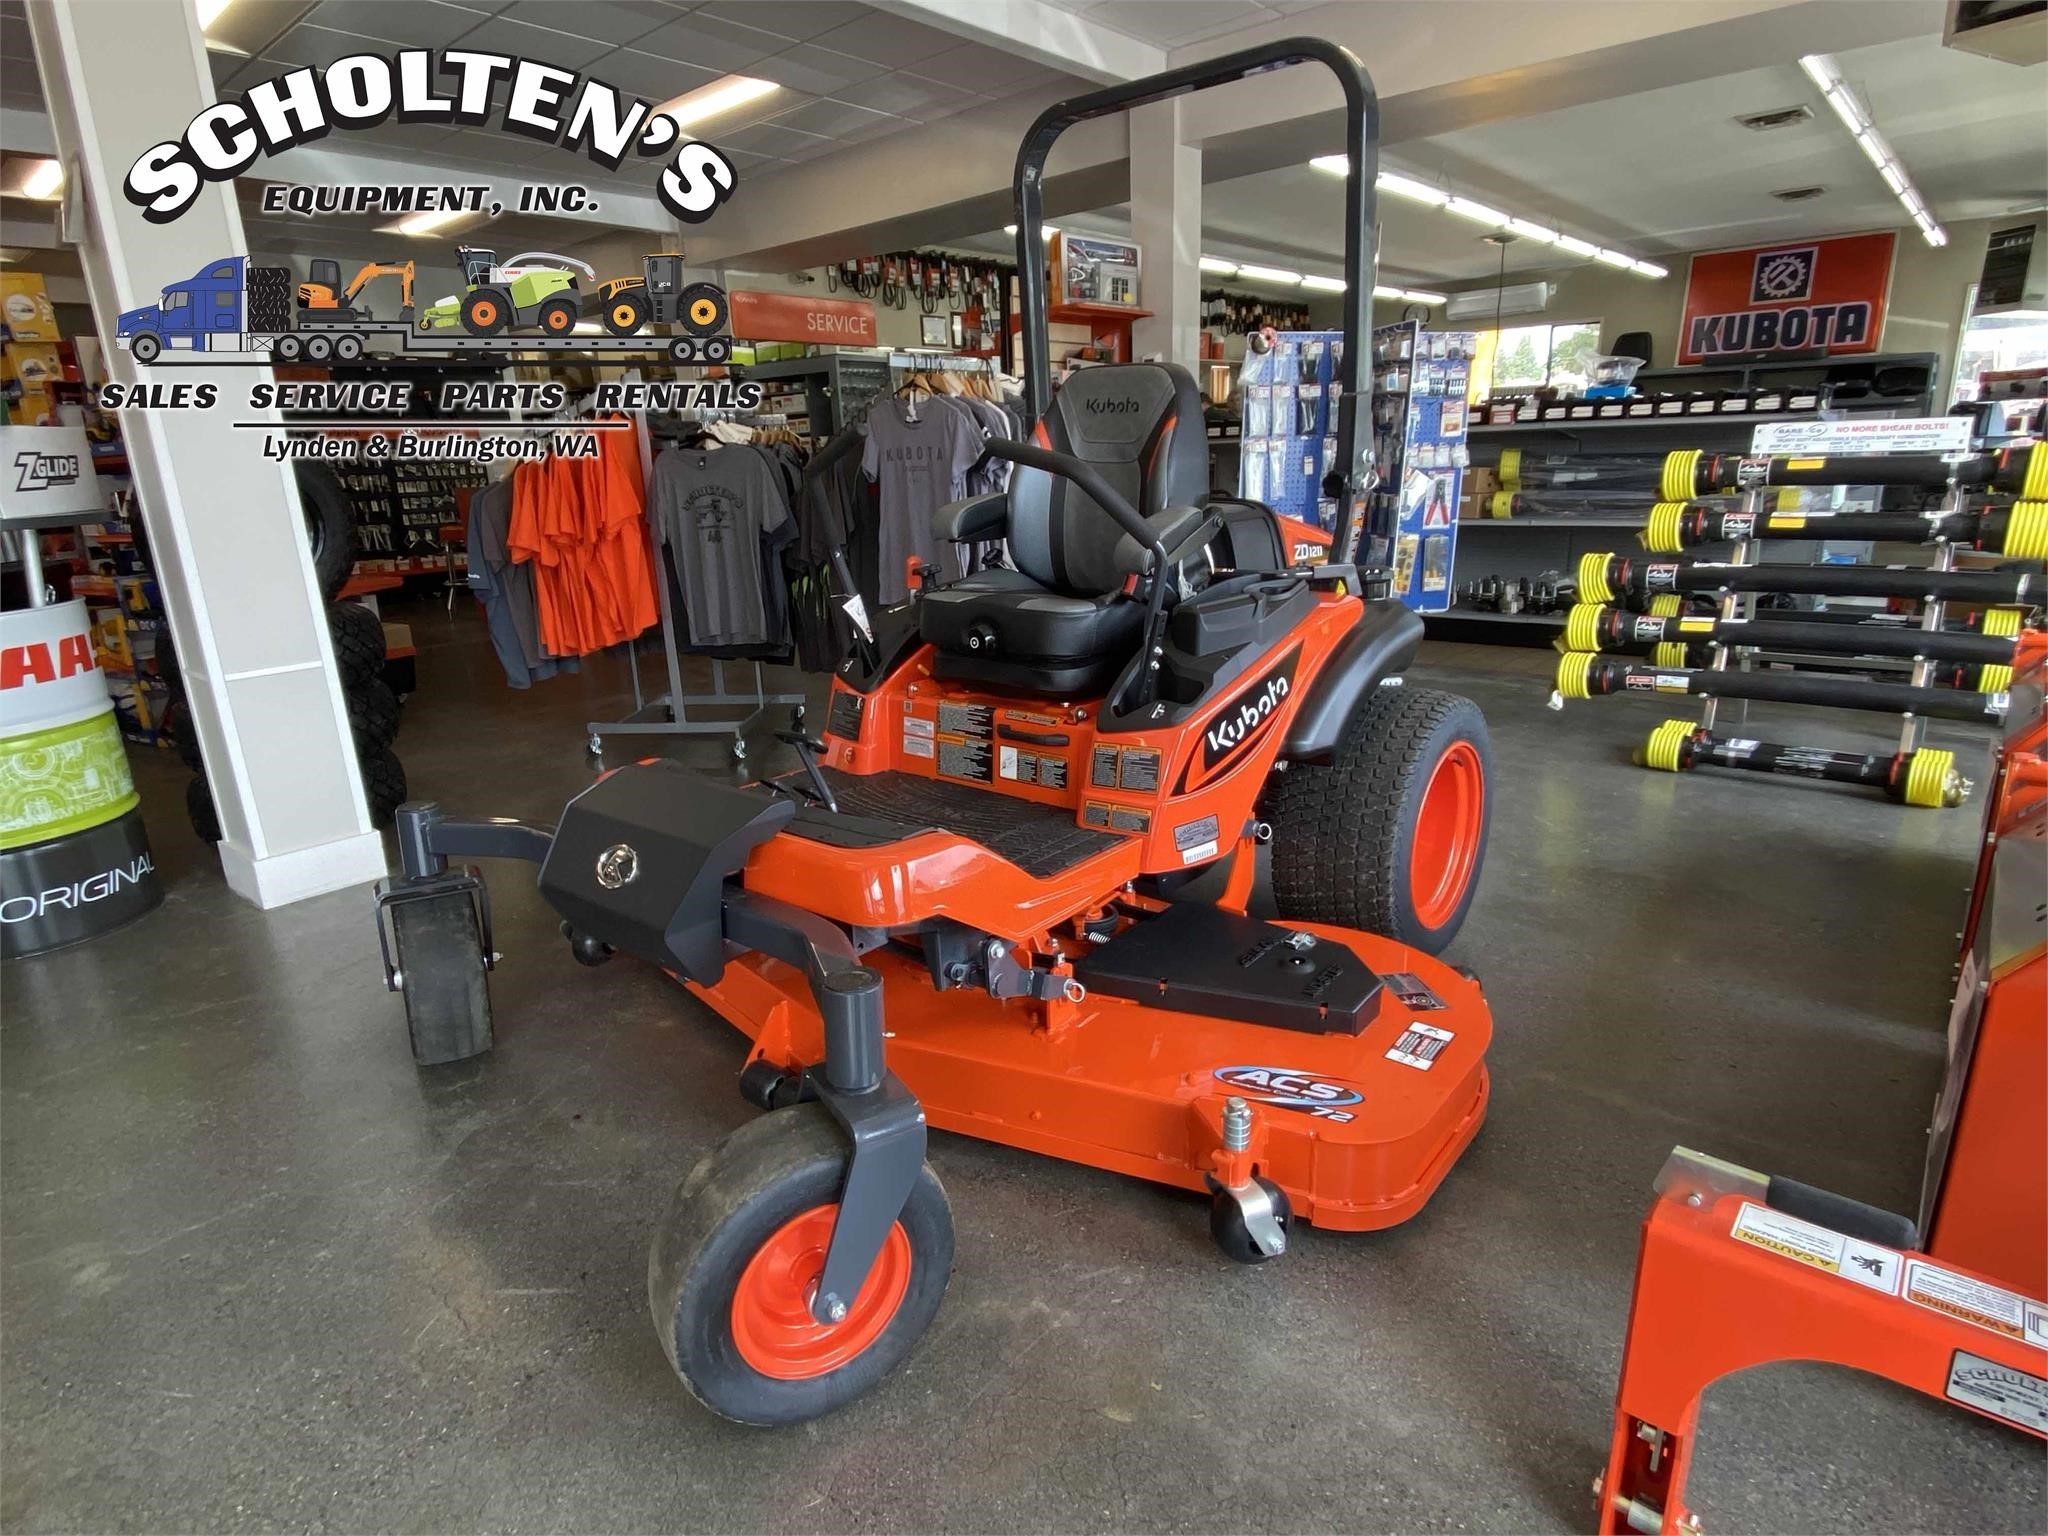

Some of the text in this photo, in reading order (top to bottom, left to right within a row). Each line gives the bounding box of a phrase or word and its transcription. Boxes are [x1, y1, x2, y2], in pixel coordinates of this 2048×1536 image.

[807, 312, 868, 335] SERVICE
[1689, 303, 1870, 355] KUBOTA
[1085, 396, 1140, 414] Kubota
[1880, 424, 1913, 432] SHEAR
[1913, 422, 1950, 431] BOLTS!
[886, 446, 944, 463] KUBOTA
[1207, 676, 1289, 752] Kubota
[0, 851, 155, 924] ORIGINAL
[1233, 1069, 1345, 1101] ACS
[1310, 1106, 1355, 1123] 72
[1742, 1231, 1816, 1262] CAUTION
[1911, 1290, 2001, 1329] WARNING
